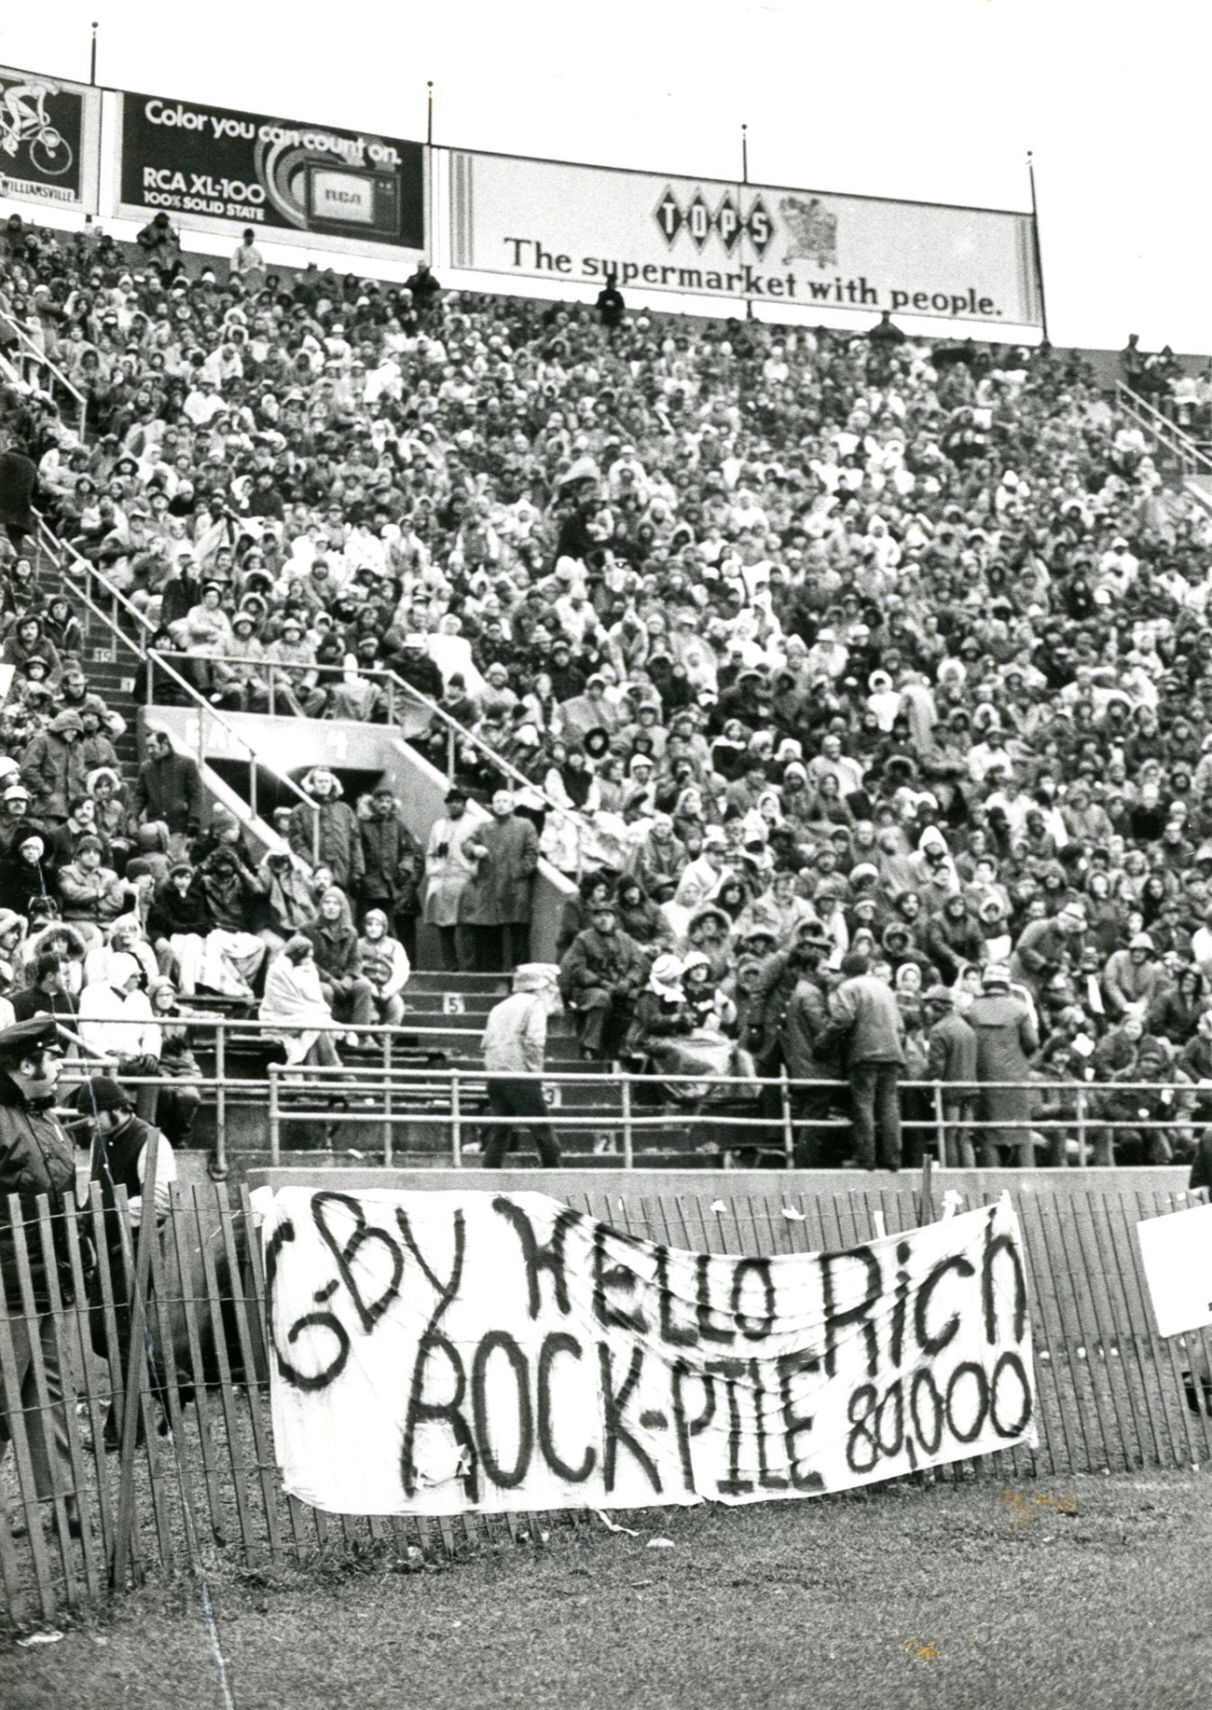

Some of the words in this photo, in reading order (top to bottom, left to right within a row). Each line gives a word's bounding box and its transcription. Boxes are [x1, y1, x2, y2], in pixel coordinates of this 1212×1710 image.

[145, 99, 207, 132] Color
[210, 116, 255, 140] you
[258, 123, 300, 147] can
[302, 127, 364, 159] count
[367, 141, 402, 165] on.
[2, 180, 72, 202] WILLIAMSVILLE
[143, 166, 186, 193] RCA
[189, 174, 266, 205] XL-100
[143, 190, 182, 209] 100%
[183, 194, 224, 216] SOLID
[226, 203, 265, 222] STATE
[658, 200, 770, 246] TOPS
[504, 236, 573, 274] The
[581, 256, 798, 299] supermarket
[807, 274, 879, 306] with
[890, 286, 1004, 319] people.
[491, 1197, 777, 1348] HELLO
[400, 1328, 828, 1504] ROCK-PILE
[845, 1350, 1034, 1474] 80,000
